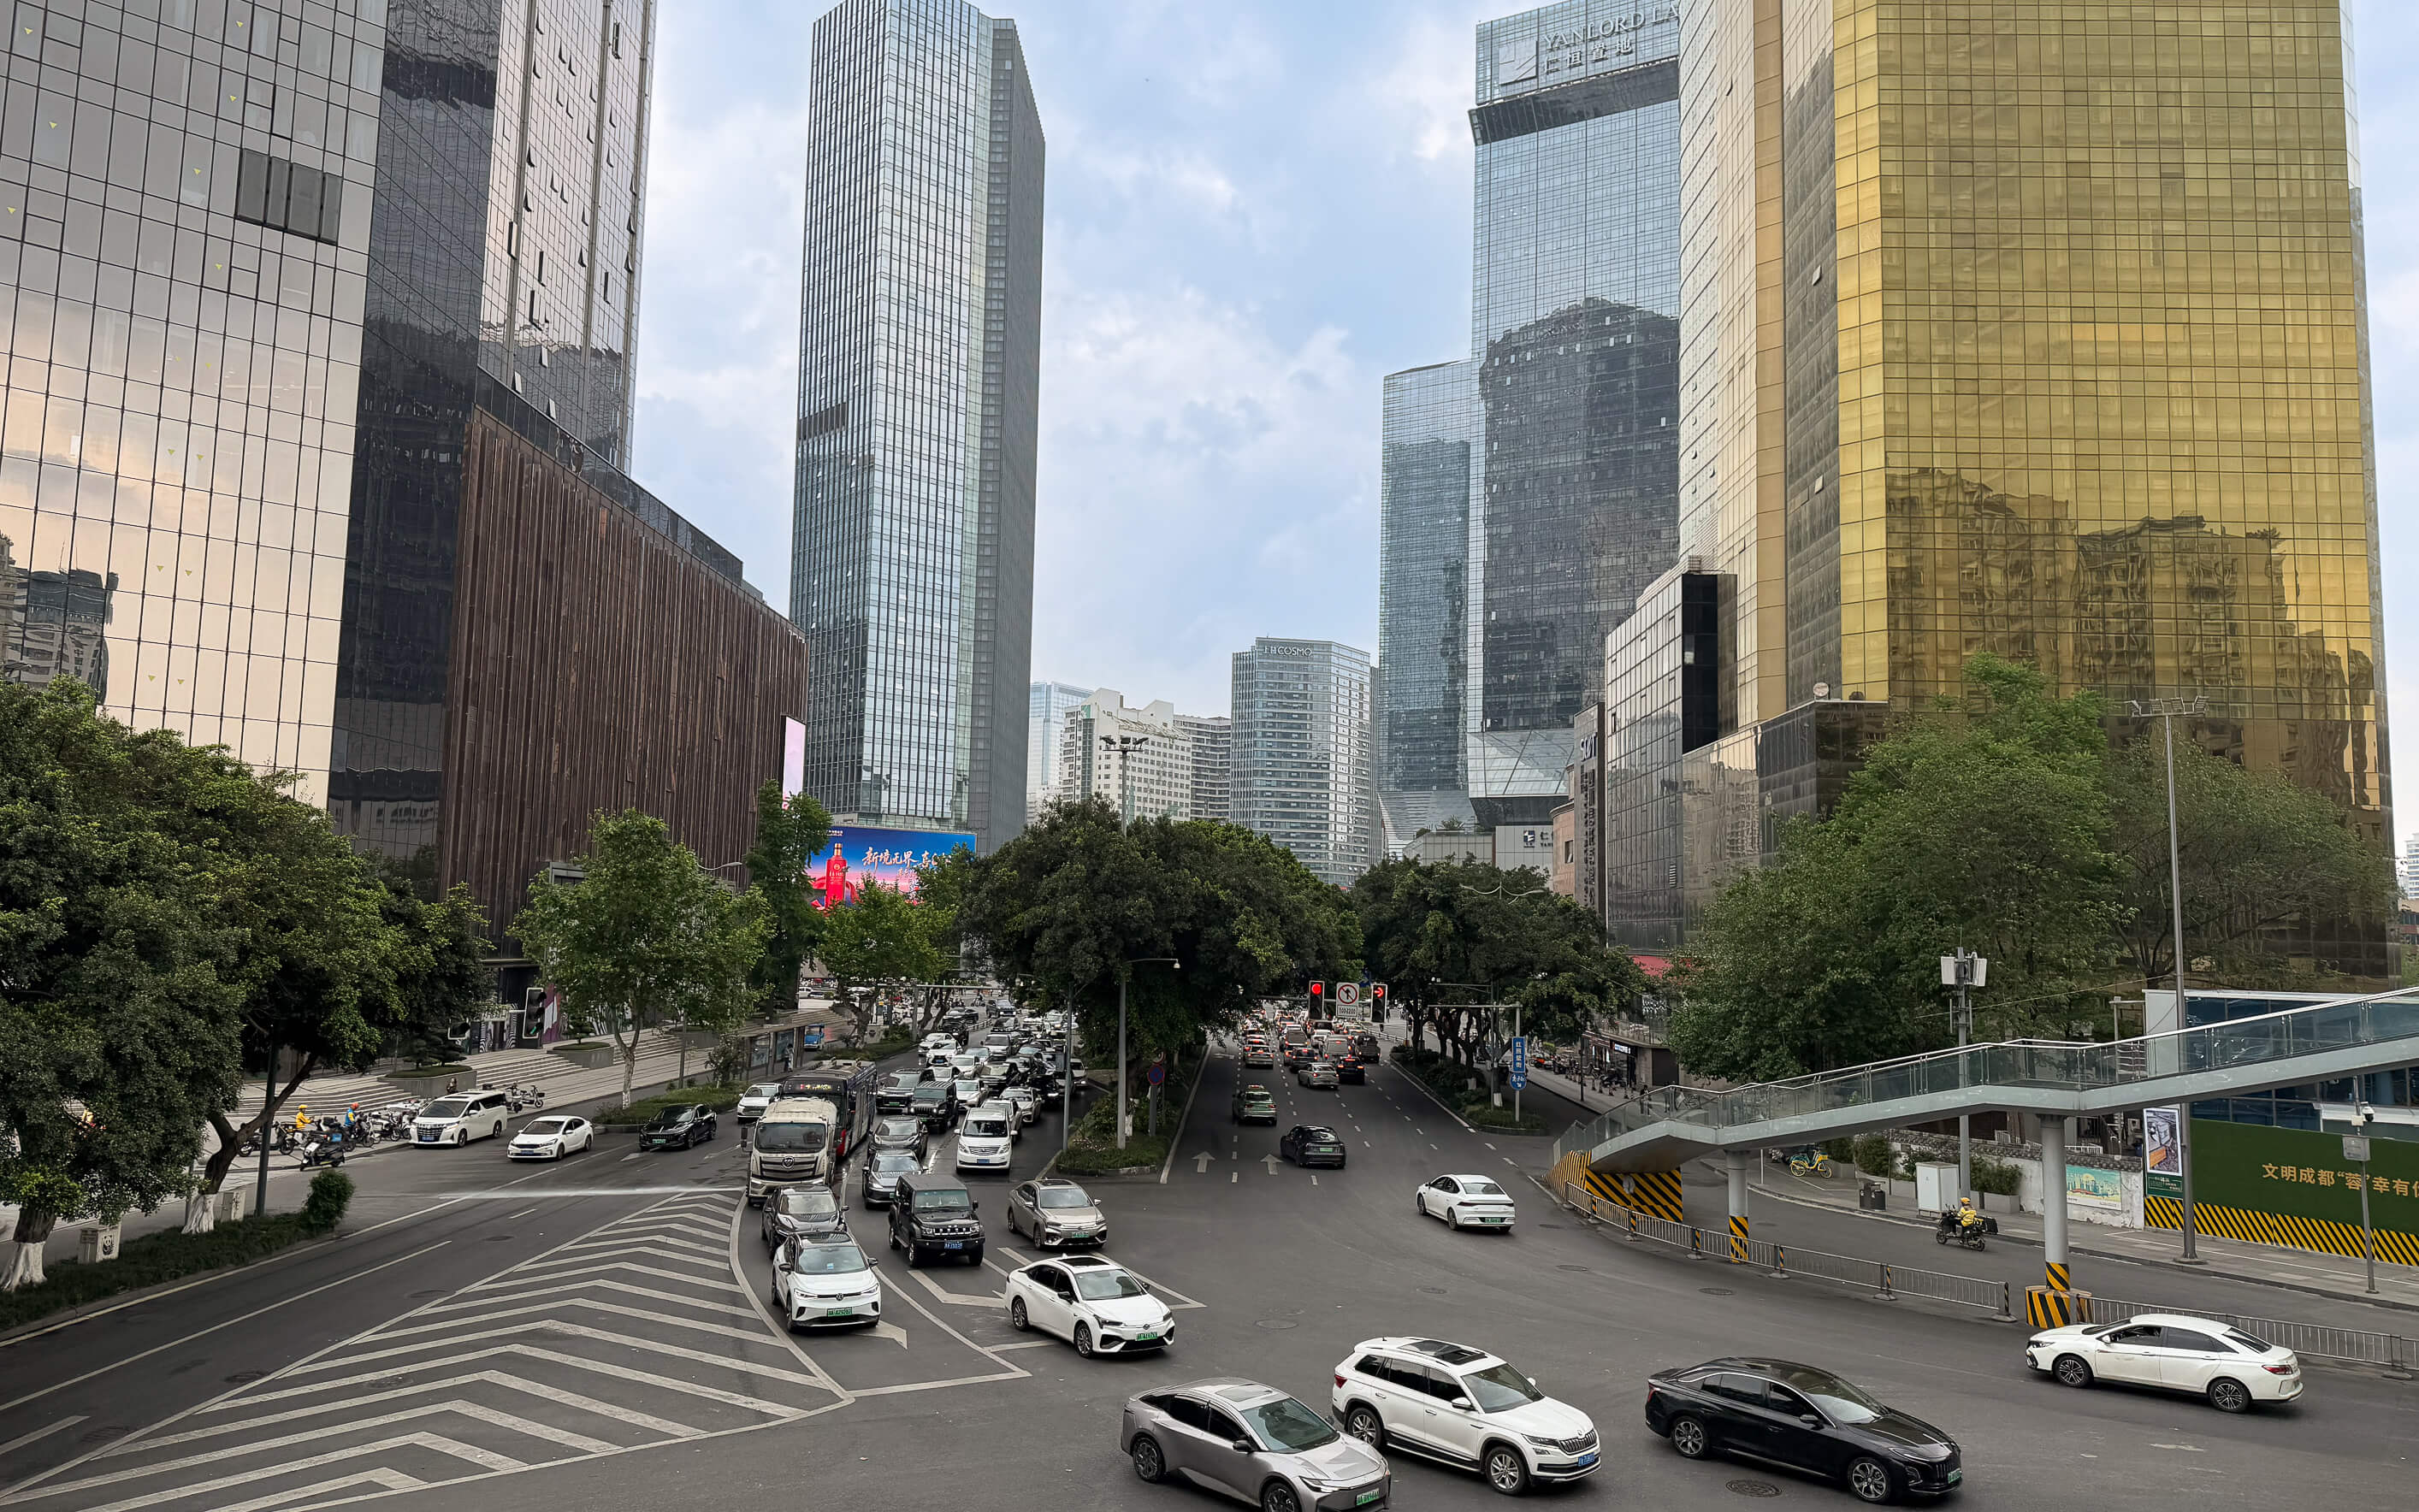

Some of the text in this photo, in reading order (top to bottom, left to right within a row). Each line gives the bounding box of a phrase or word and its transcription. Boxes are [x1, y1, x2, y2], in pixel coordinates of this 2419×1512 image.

[1543, 10, 1646, 51] YANLORD
[1543, 36, 1633, 74] 仁恒置地
